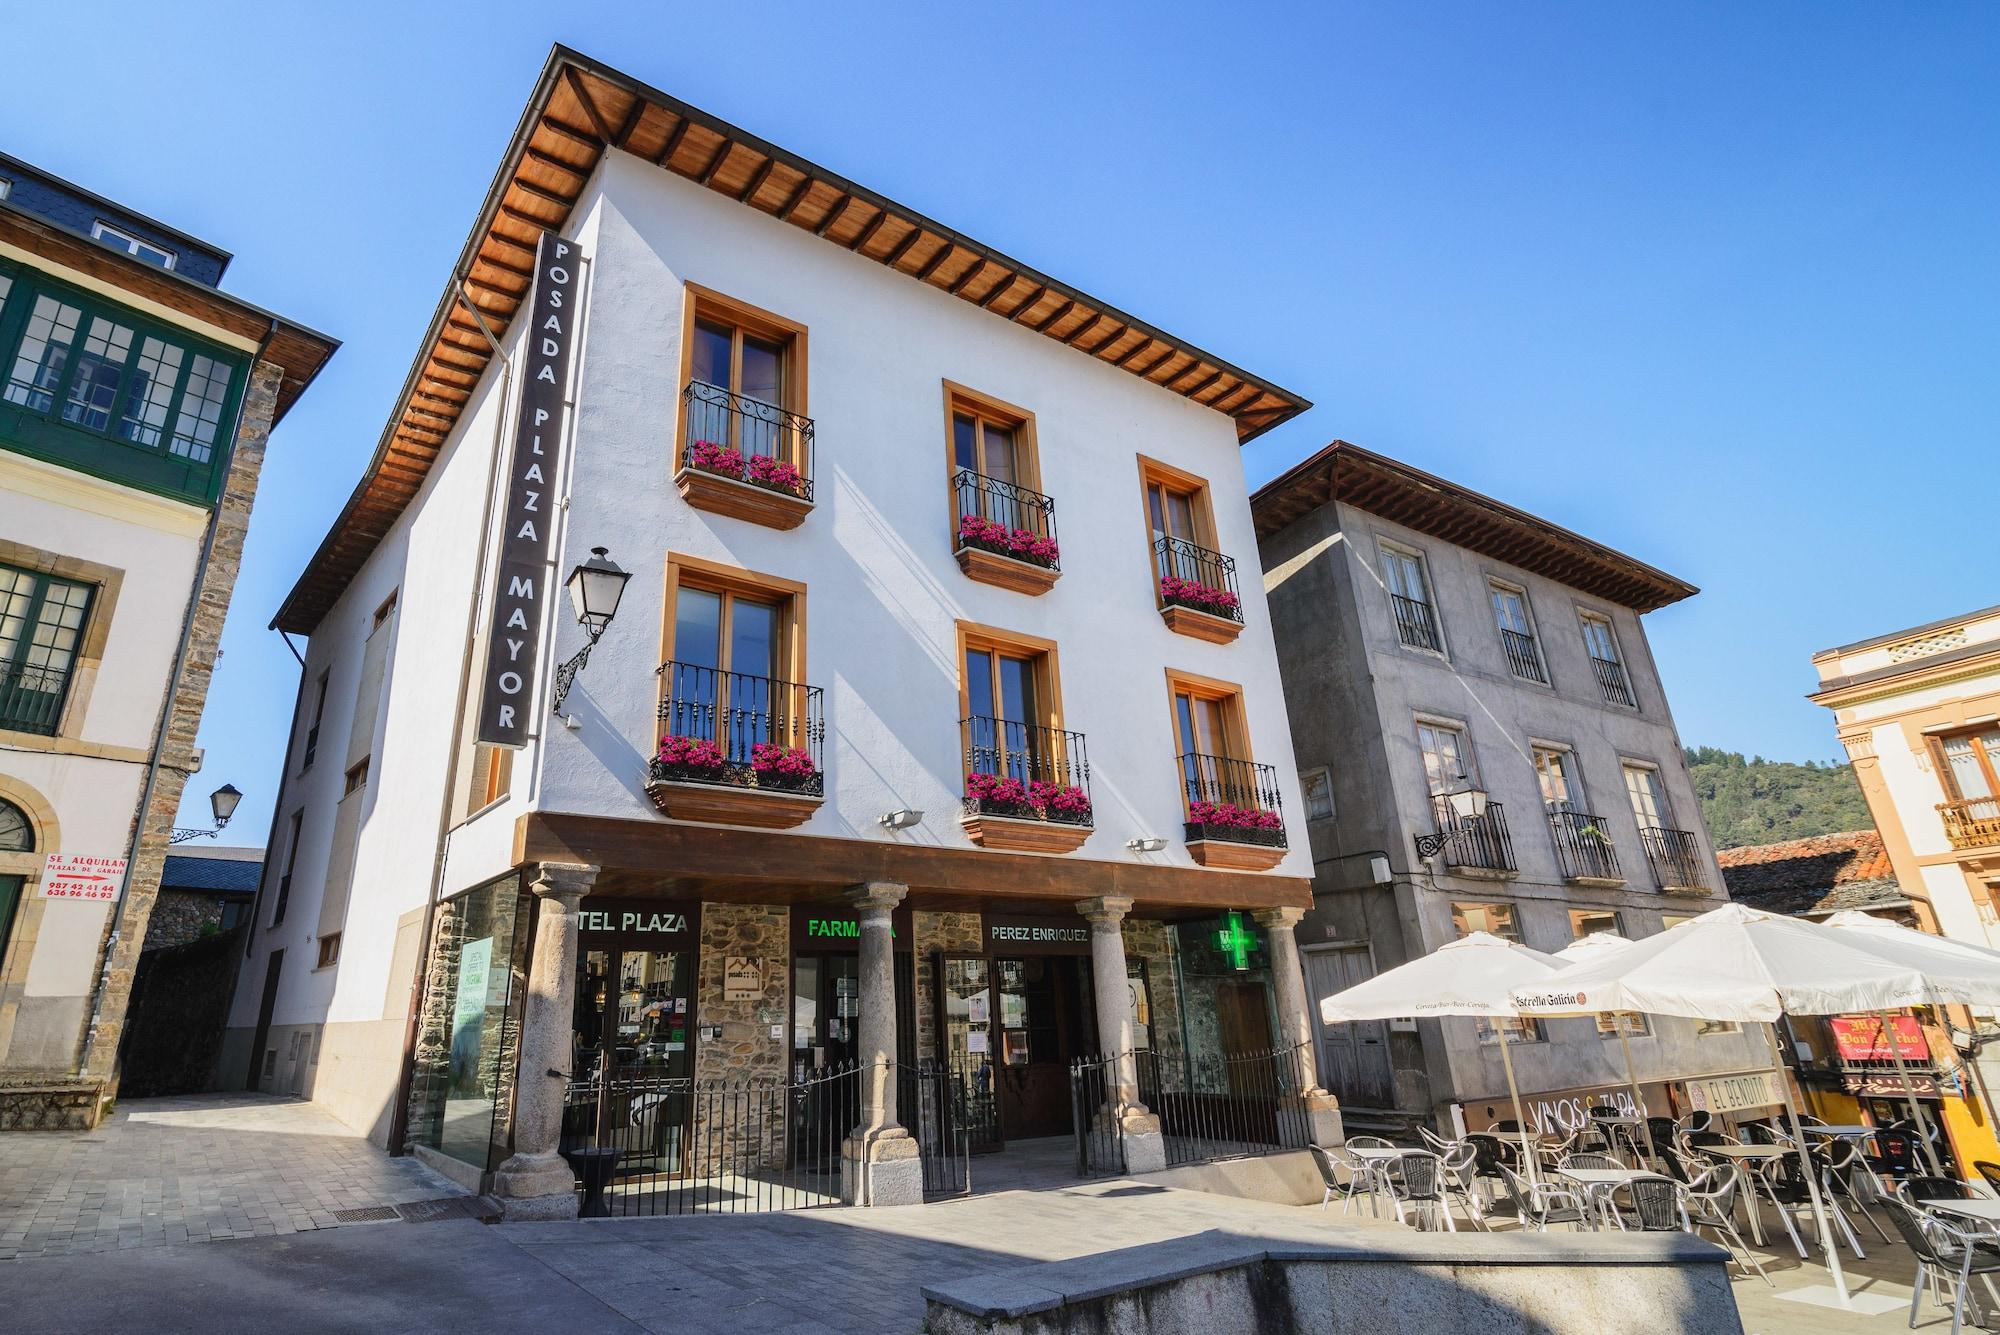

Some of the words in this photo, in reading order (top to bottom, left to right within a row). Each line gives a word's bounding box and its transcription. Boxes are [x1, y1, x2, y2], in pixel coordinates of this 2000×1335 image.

[537, 243, 569, 385] POSADA
[516, 408, 550, 543] PLAZA
[497, 576, 534, 729] MAYOR
[47, 864, 76, 872] PLAZAS
[49, 855, 64, 863] SE
[72, 856, 126, 867] ALQUILAN
[578, 911, 616, 931] TEL
[622, 912, 688, 933] PLAZA
[808, 919, 897, 939] FARM
[991, 926, 1030, 940] PEREZ
[1032, 927, 1088, 942] ENRIQUEZ
[1547, 993, 1576, 1006] Galicia
[1841, 1032, 1868, 1046] Don
[1708, 1081, 1727, 1109] EL
[1724, 1076, 1769, 1107] BENDITO
[1528, 1097, 1586, 1134] VINOS
